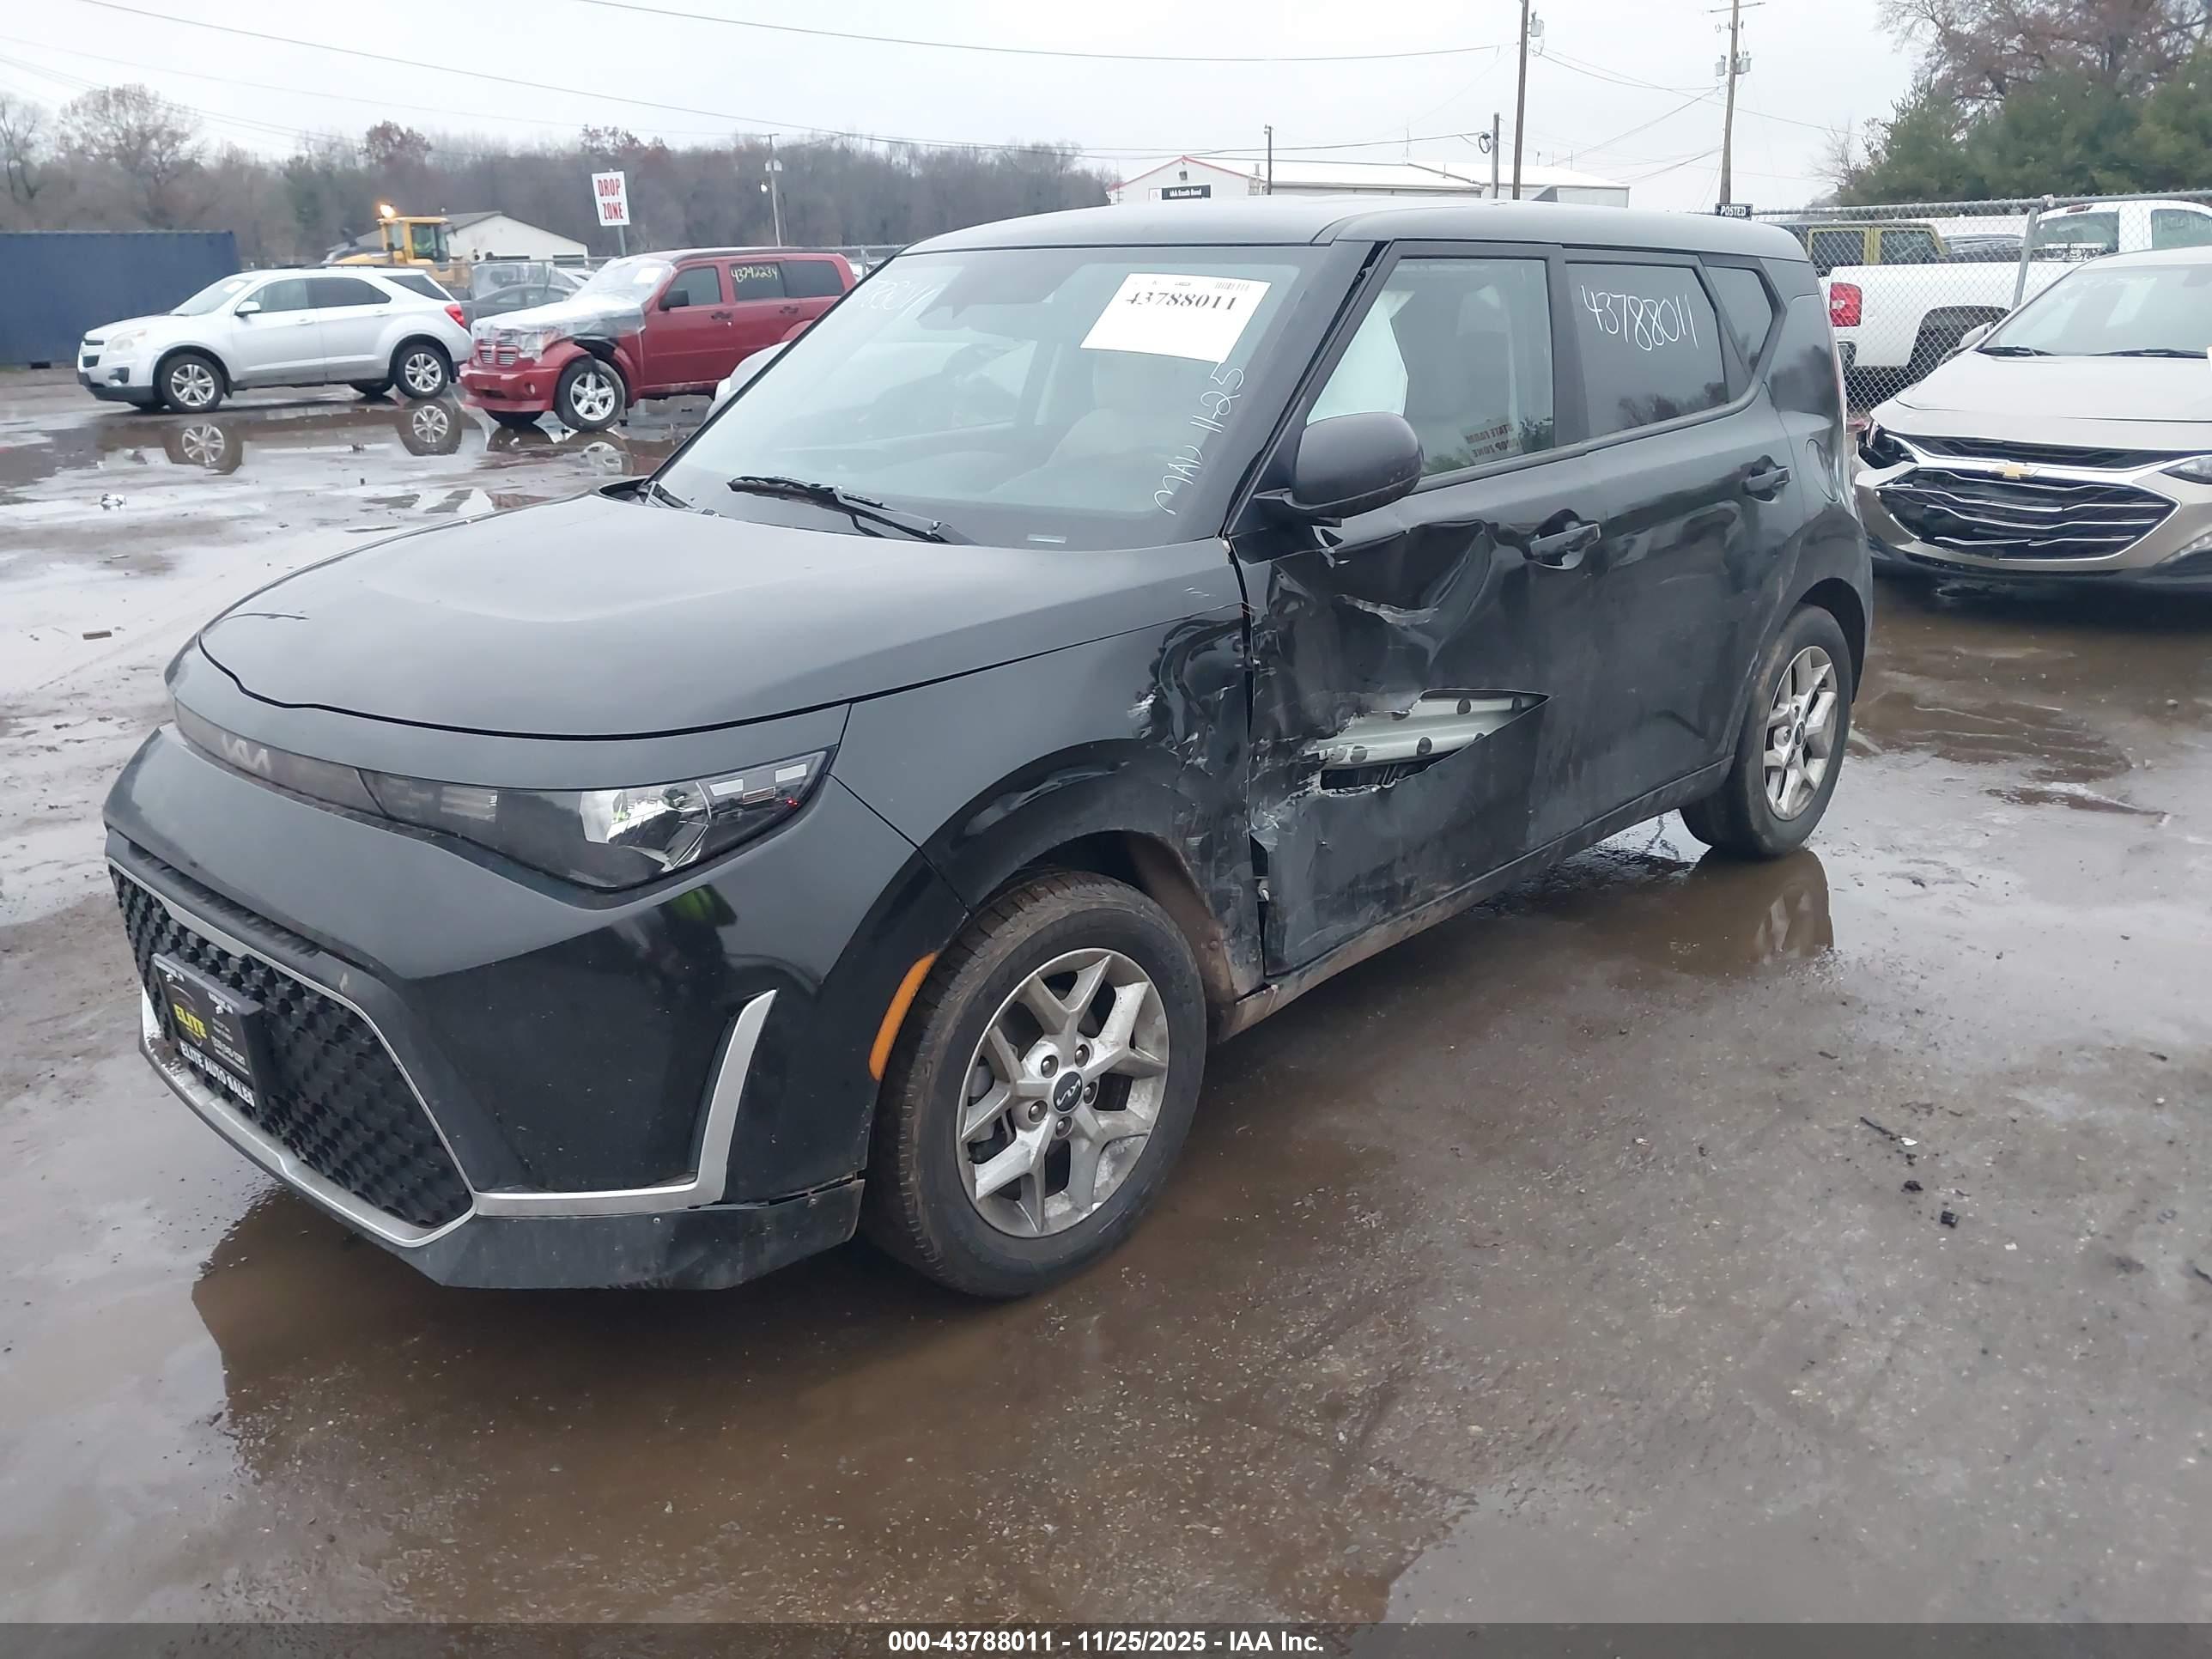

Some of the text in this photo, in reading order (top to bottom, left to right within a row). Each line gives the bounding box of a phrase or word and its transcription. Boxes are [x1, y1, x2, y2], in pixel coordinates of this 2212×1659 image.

[598, 178, 620, 197] DROP
[603, 202, 623, 220] ZONE
[1721, 205, 1747, 216] POSTED
[1125, 291, 1237, 311] 43788011
[1581, 284, 1698, 351] 43788011
[1189, 362, 1244, 434] 11-25
[173, 1003, 208, 1040] ELITE
[179, 1041, 204, 1070] ELITE
[204, 1057, 227, 1085] AUTO
[226, 1074, 256, 1108] SALES
